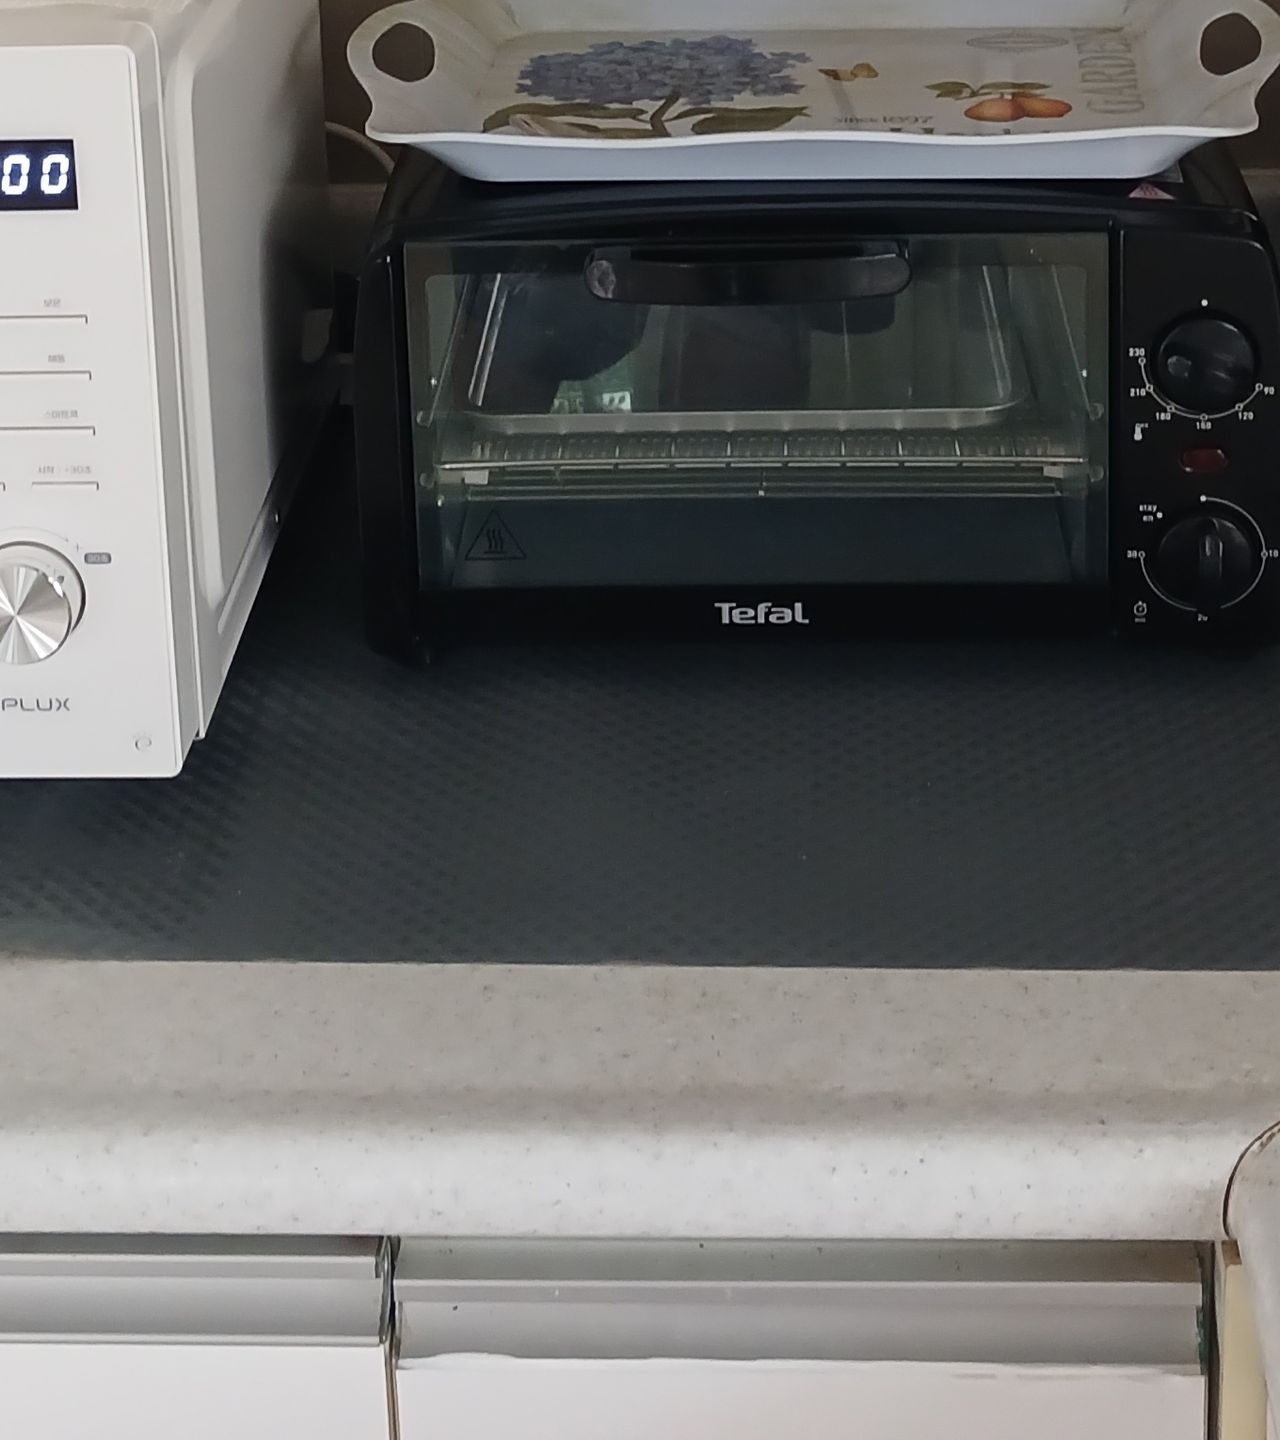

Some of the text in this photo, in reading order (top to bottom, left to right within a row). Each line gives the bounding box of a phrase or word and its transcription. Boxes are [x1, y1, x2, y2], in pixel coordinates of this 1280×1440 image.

[1128, 347, 1146, 357] 230
[1129, 387, 1147, 397] 210
[1263, 386, 1275, 396] 90
[1238, 411, 1254, 421] 120
[713, 601, 811, 625] Tefal
[0, 696, 71, 713] PLUX
